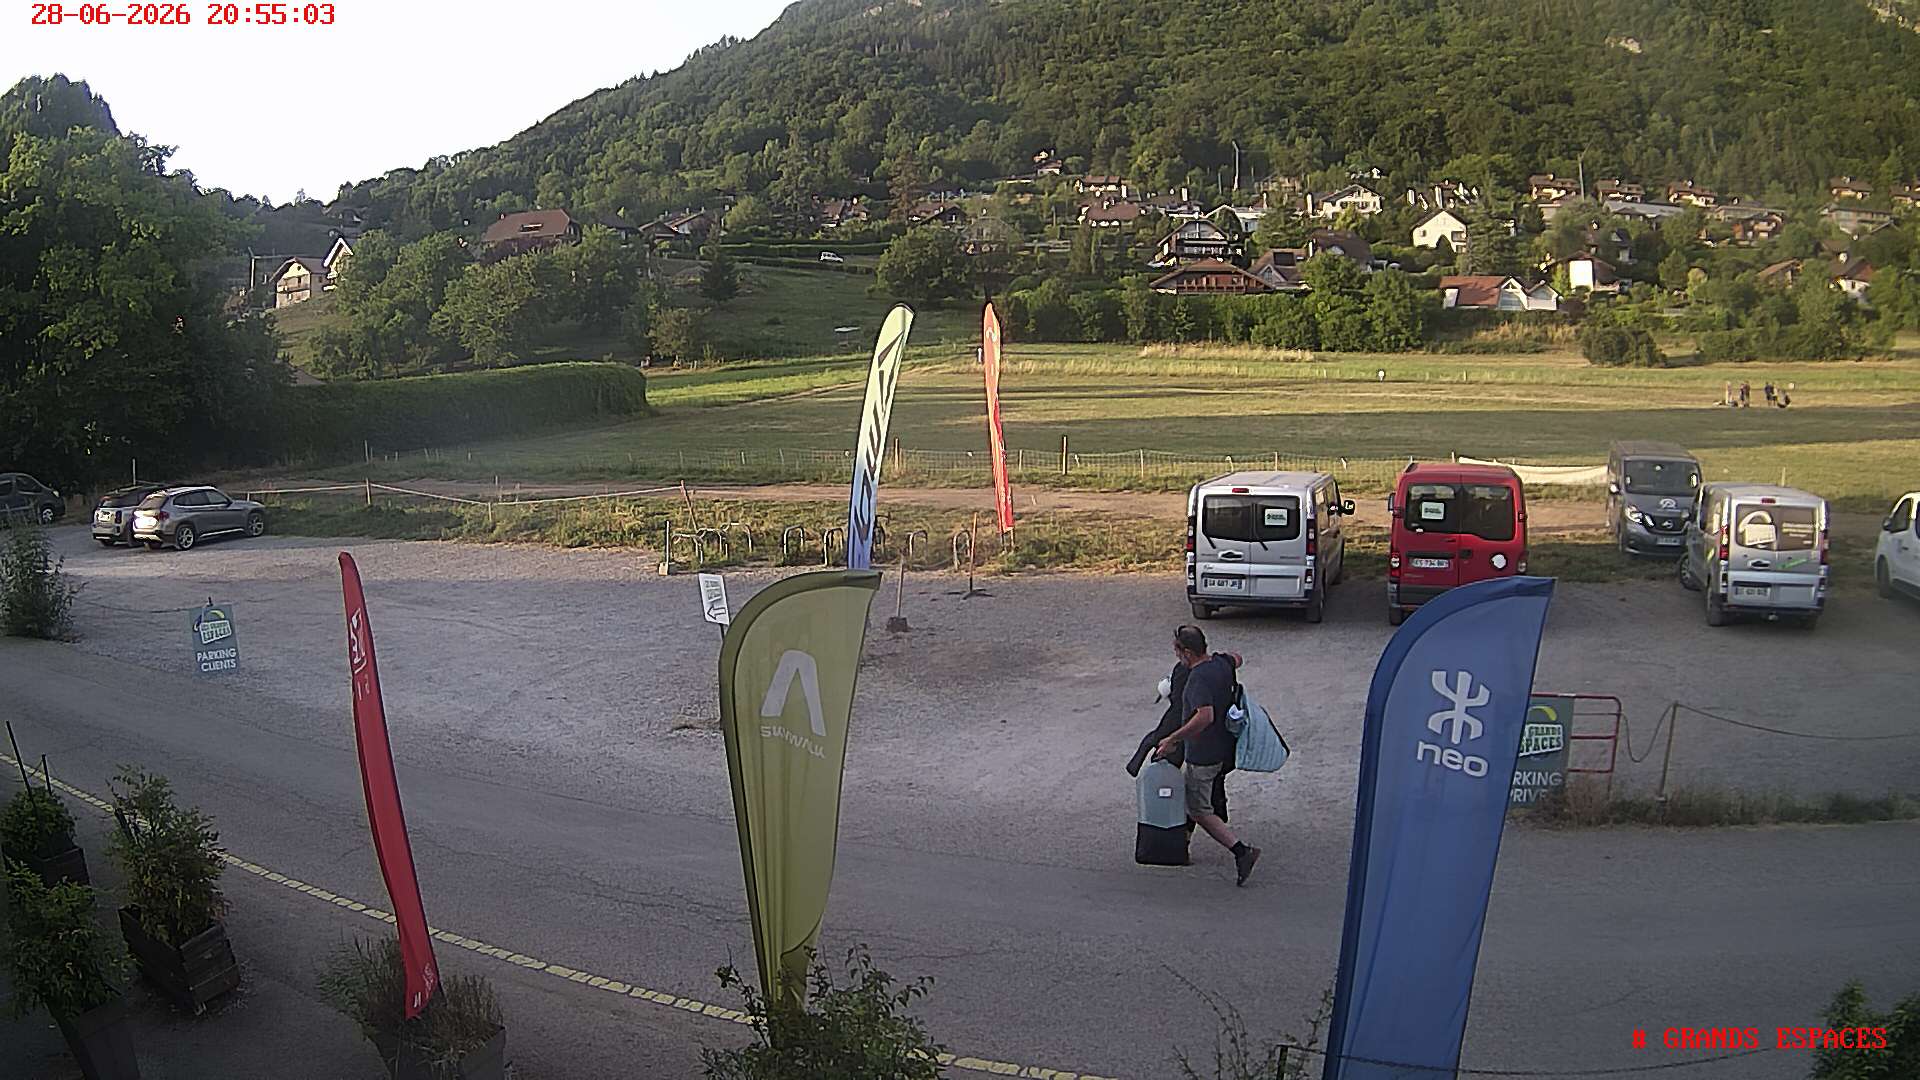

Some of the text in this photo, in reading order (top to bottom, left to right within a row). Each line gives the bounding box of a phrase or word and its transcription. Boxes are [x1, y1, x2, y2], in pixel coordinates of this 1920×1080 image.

[196, 648, 237, 662] PARKING
[201, 658, 237, 672] CLIENTS
[1520, 736, 1563, 753] SPACES
[1416, 740, 1489, 777] neo
[1512, 770, 1563, 786] RKING
